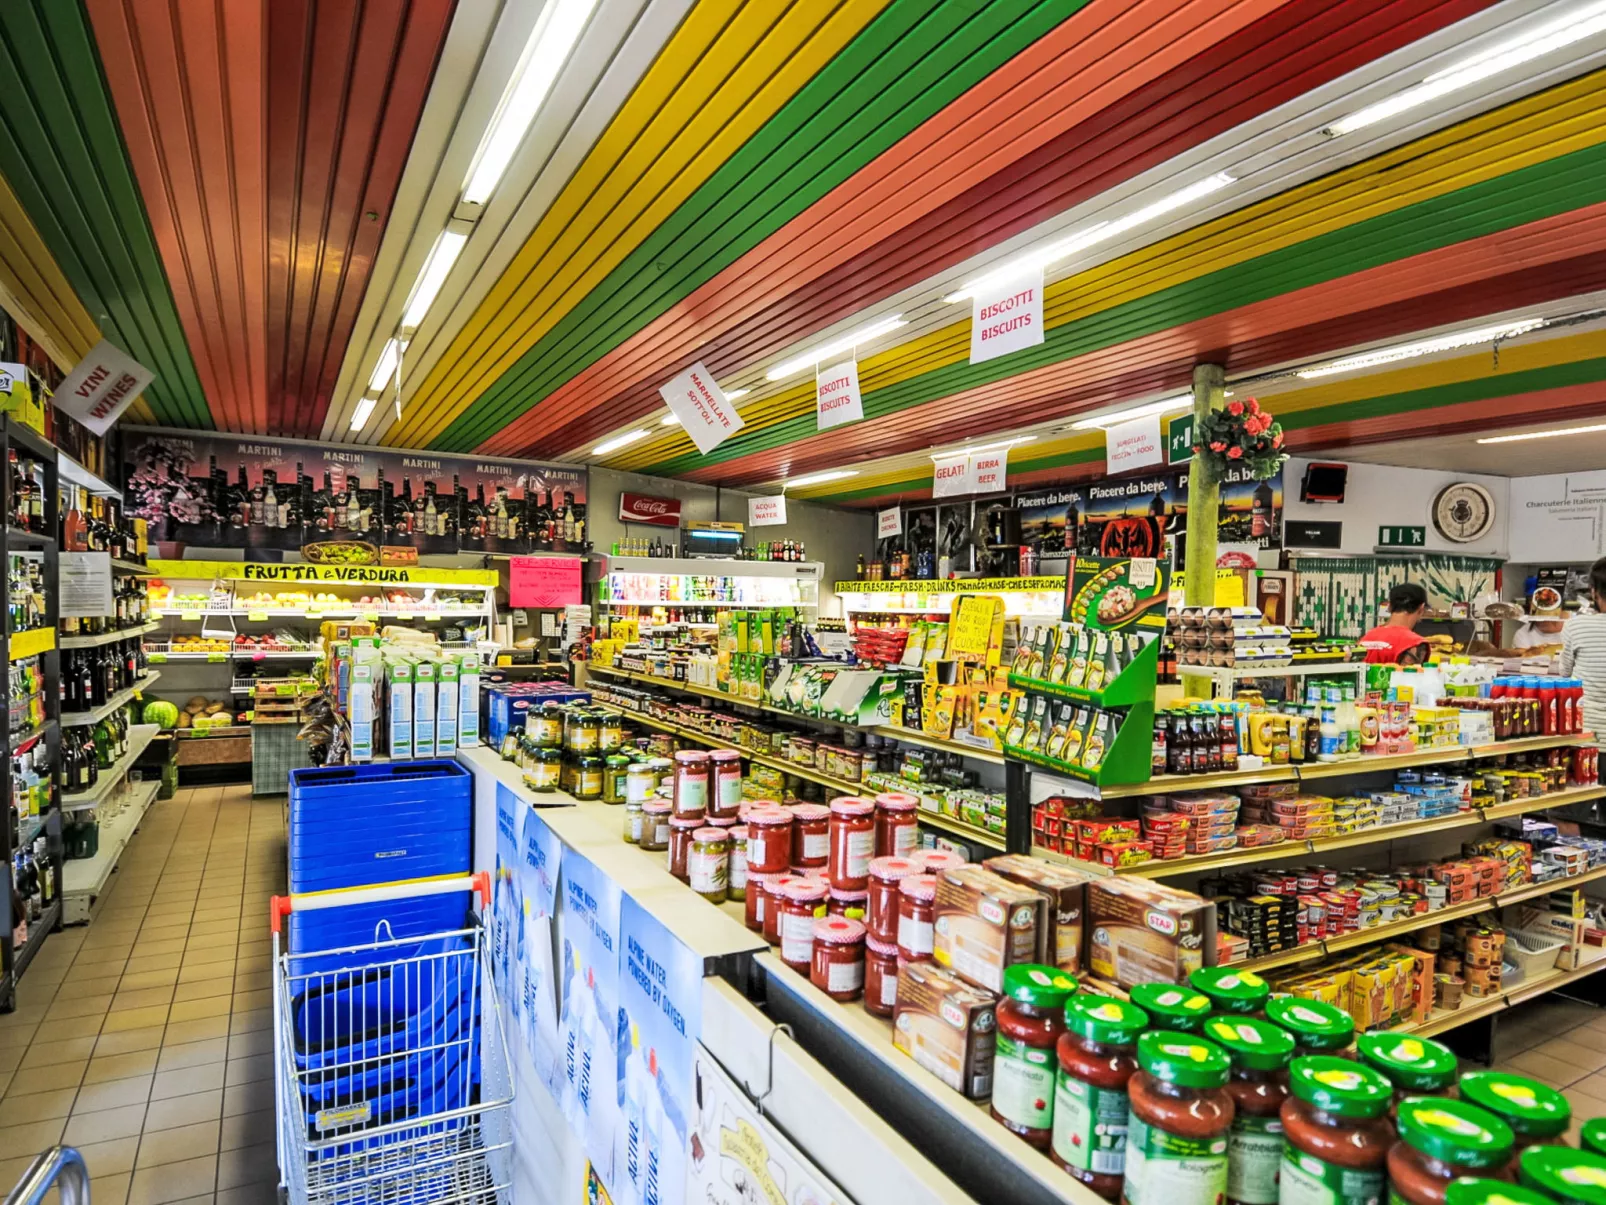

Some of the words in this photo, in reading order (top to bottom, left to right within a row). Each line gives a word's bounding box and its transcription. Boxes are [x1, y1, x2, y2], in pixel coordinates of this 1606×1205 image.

[980, 289, 1034, 320] BISCOTTI
[981, 313, 1032, 341] BISCUITS
[75, 365, 110, 398] VINI
[819, 376, 850, 397] BISCOTTI
[90, 373, 137, 419] WINES
[690, 372, 732, 429] MARMELLATE
[820, 395, 851, 413] BISCUITS
[238, 444, 282, 457] MARTINI
[323, 451, 364, 463] MARTINI
[402, 458, 441, 469] MARTINI
[476, 464, 512, 475] MARTINI
[977, 459, 999, 469] BIRRA
[546, 470, 579, 480] MARTINI
[978, 474, 996, 483] BEER
[1090, 486, 1125, 499] Piacere
[1126, 483, 1139, 495] da
[1140, 480, 1168, 493] bere.
[755, 503, 777, 511] ACQUA
[1017, 496, 1046, 508] Piacere
[1047, 494, 1058, 504] da
[1526, 499, 1571, 508] Charcuterie
[755, 512, 778, 520] WATER
[244, 565, 318, 579] FRUTTA
[324, 570, 334, 578] e
[335, 568, 409, 581] VERDURA
[927, 581, 956, 592] DRINKS
[1150, 915, 1172, 930] STAR
[628, 935, 645, 966] ALPINE
[628, 955, 651, 997] POWERED
[653, 985, 661, 1006] BY
